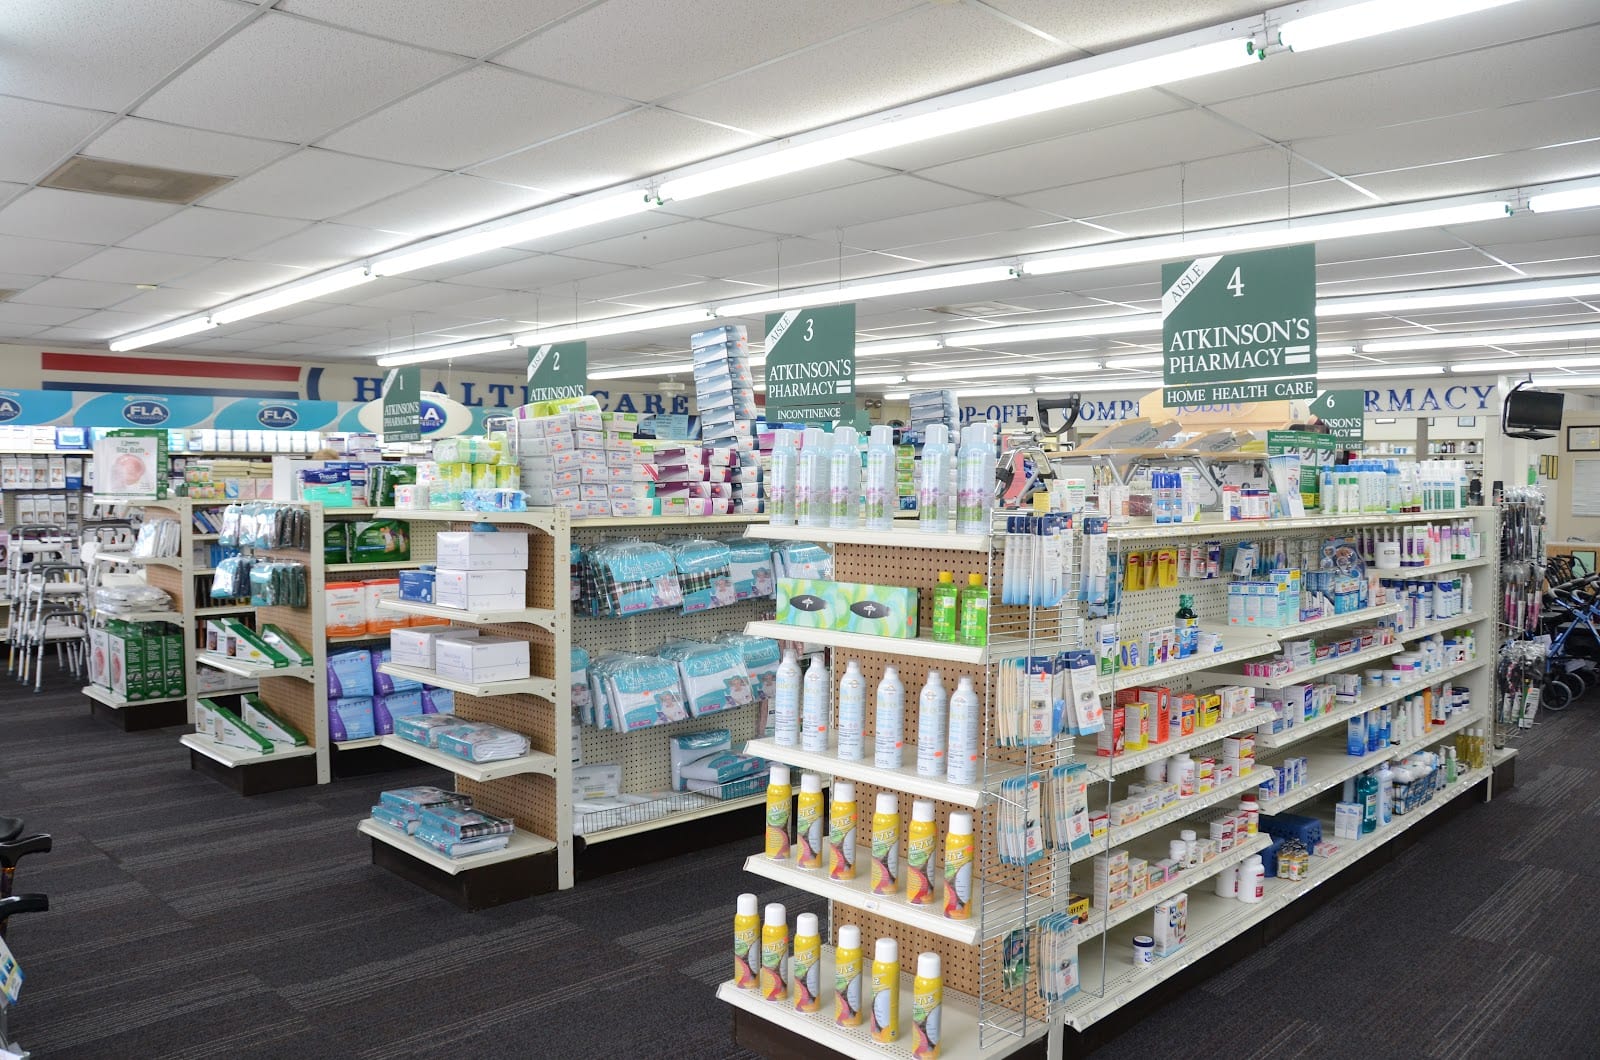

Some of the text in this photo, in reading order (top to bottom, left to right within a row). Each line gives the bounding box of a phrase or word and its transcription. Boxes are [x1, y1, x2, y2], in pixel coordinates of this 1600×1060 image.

[1171, 263, 1206, 303] AISLE
[1226, 266, 1245, 297] 4
[770, 315, 791, 344] AISLE
[803, 318, 814, 341] 3
[1169, 317, 1310, 352] ATKINSON'S
[531, 350, 545, 371] AISLE
[552, 351, 561, 371] 2
[769, 359, 852, 382] ATKINSON'S
[1169, 347, 1283, 375] PHARMACY
[531, 384, 585, 403] ATKINSON'S
[769, 380, 836, 399] PHARMACY
[1167, 381, 1315, 403] HOME HEALTH CARE
[1364, 385, 1497, 412] RMACY
[130, 405, 163, 417] FLA
[384, 402, 419, 416] ATKINSON'S
[1326, 395, 1335, 408] 6
[264, 410, 295, 422] FLA
[777, 407, 841, 420] INCONTINENCE
